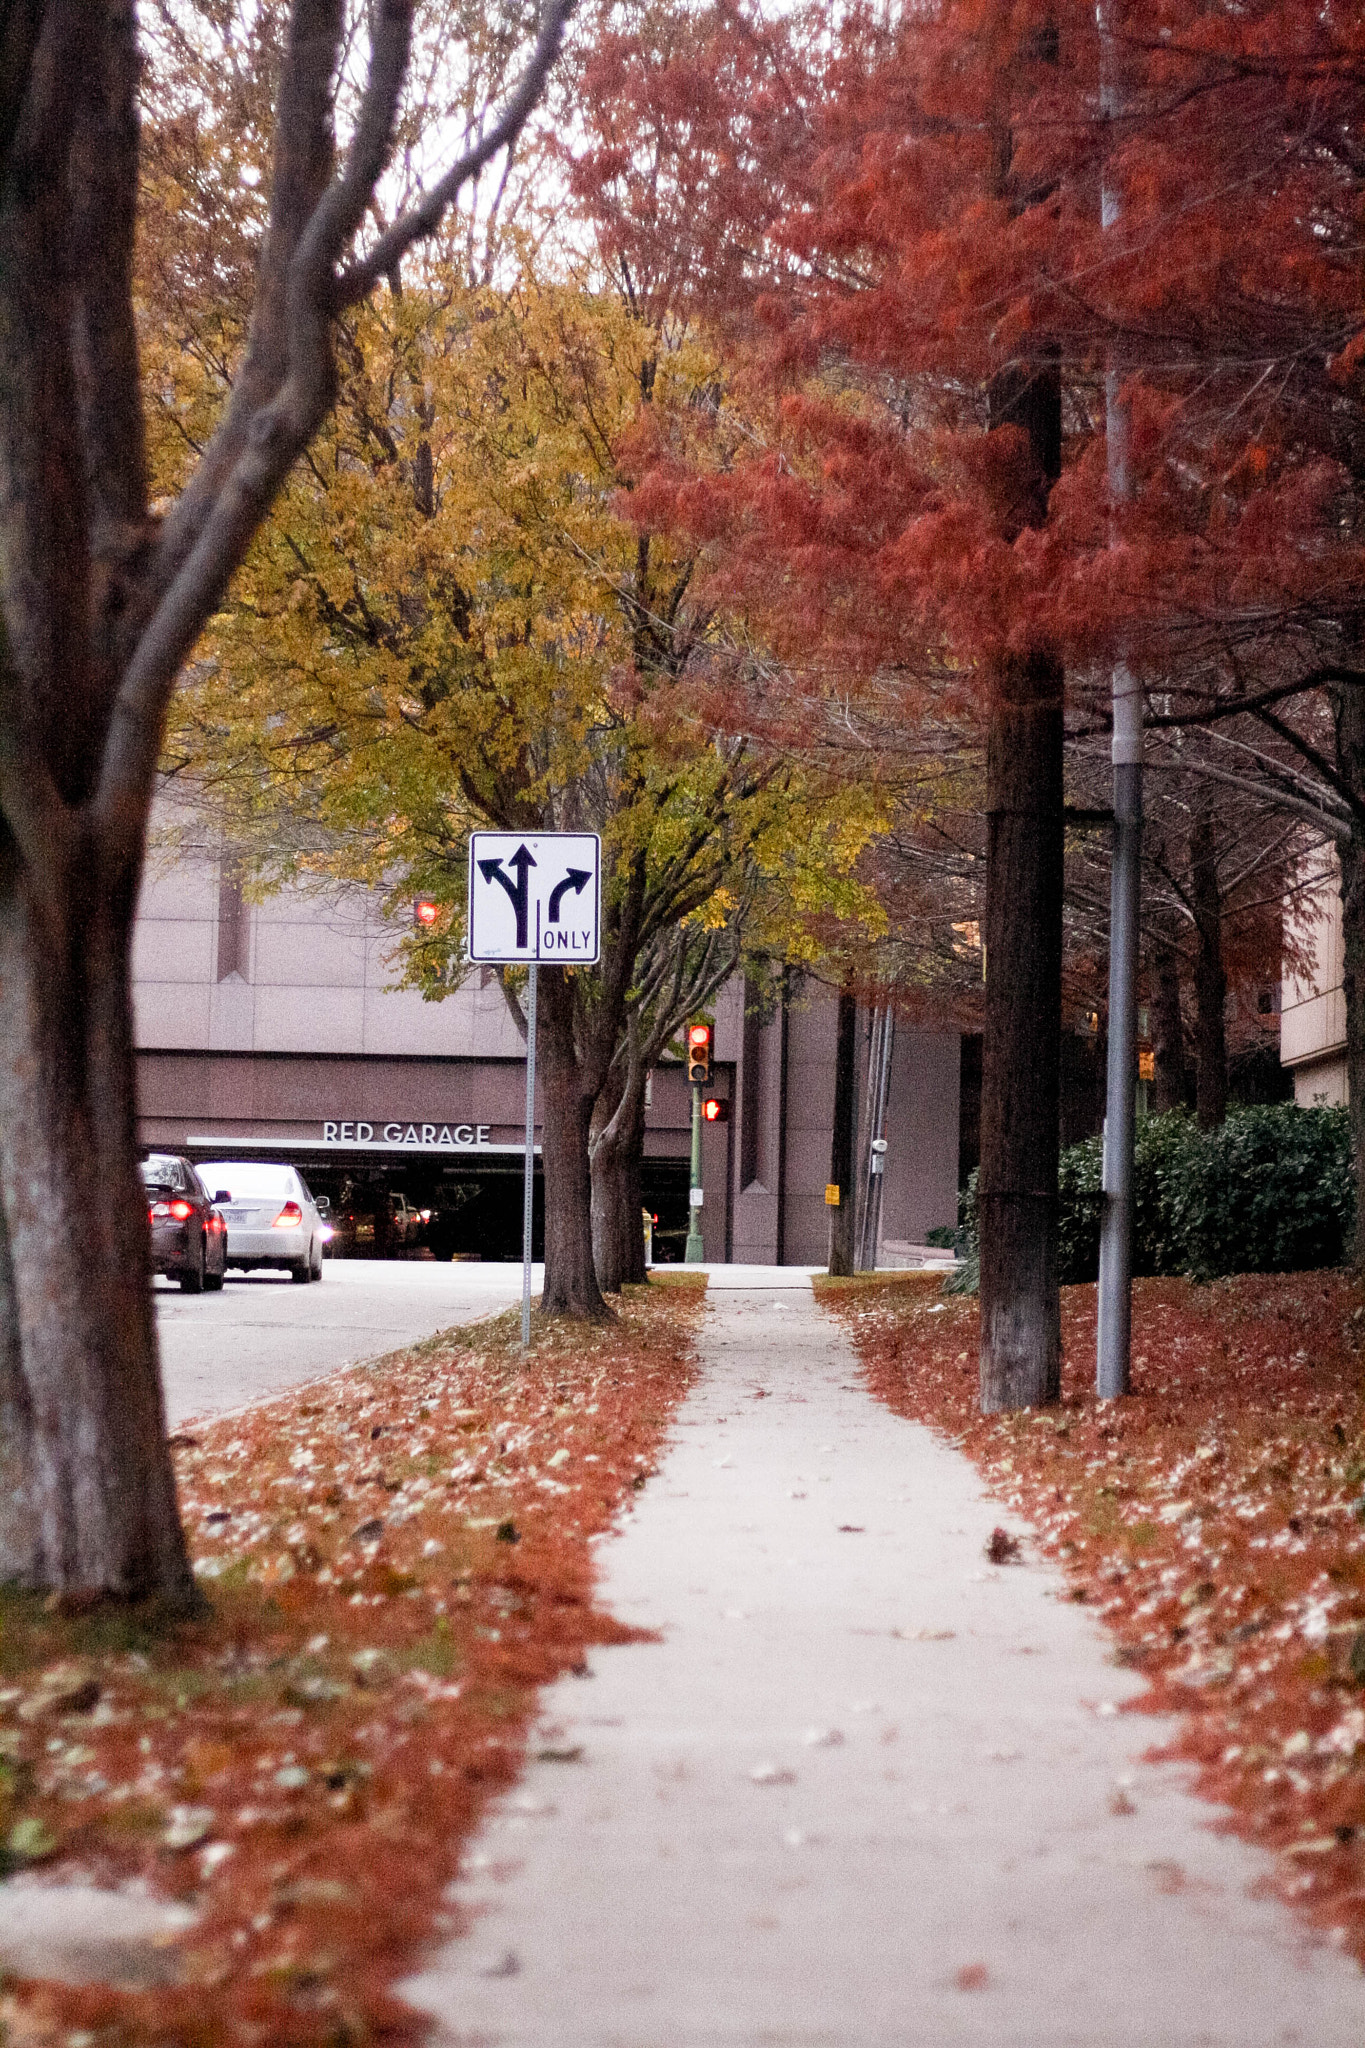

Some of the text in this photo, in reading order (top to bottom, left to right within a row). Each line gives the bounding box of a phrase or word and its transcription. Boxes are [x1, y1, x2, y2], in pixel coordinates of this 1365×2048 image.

[544, 931, 590, 949] ONLY
[323, 1122, 490, 1144] RED GARAGE
